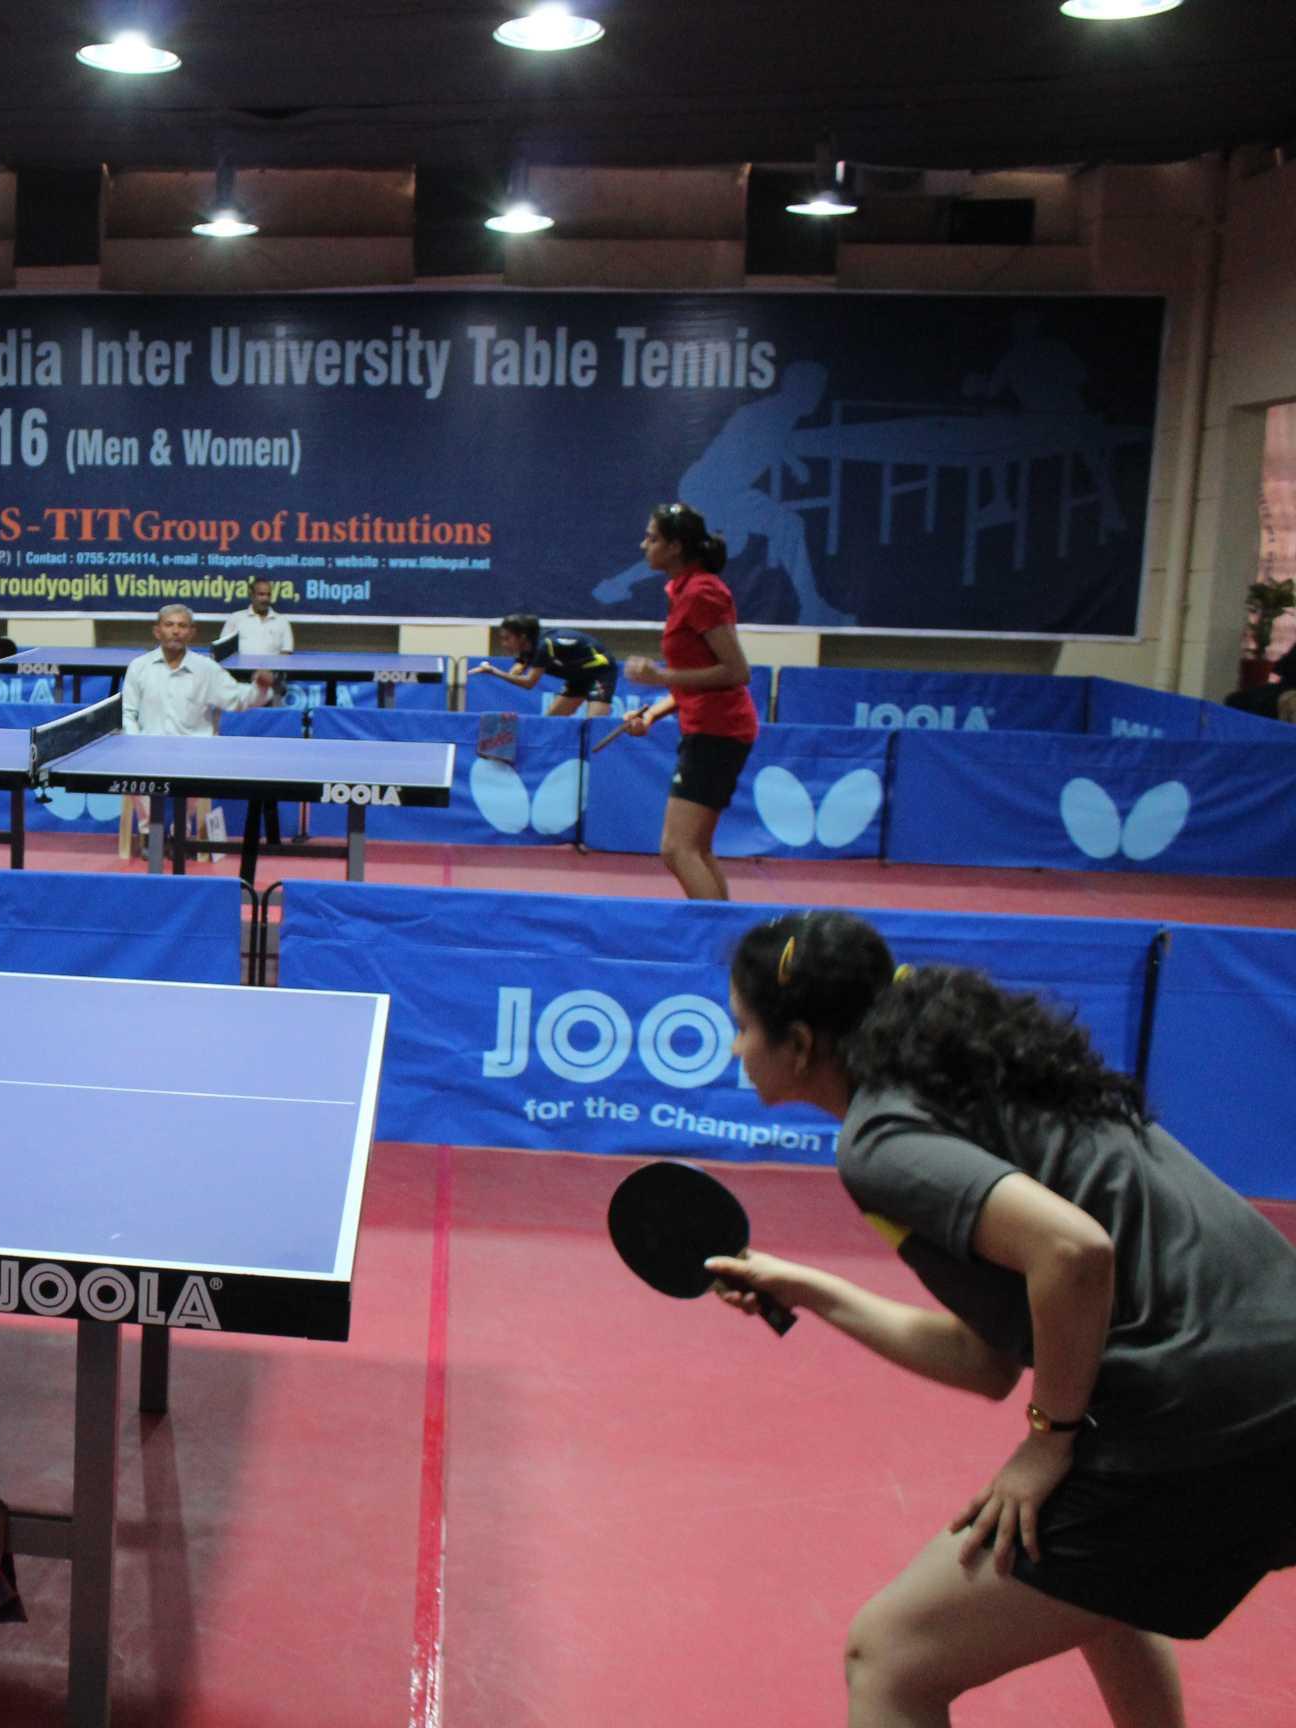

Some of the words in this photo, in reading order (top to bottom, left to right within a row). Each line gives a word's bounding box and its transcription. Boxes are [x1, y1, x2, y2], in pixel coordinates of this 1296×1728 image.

[80, 327, 192, 386] Inter
[209, 326, 451, 399] University
[467, 325, 597, 387] Table
[615, 326, 776, 389] Tennis
[66, 428, 139, 475] (Men
[150, 427, 172, 467] &
[182, 428, 302, 475] Women)
[251, 509, 289, 542] of
[296, 511, 492, 545] Institutions
[26, 552, 67, 564] Contact
[162, 553, 198, 565] e-mail
[114, 574, 299, 602] Vishwavidyaya,
[306, 579, 371, 602] Bhopal
[482, 987, 753, 1089] JOO
[524, 1097, 573, 1121] for
[584, 1097, 640, 1121] the
[649, 1102, 821, 1152] Champion
